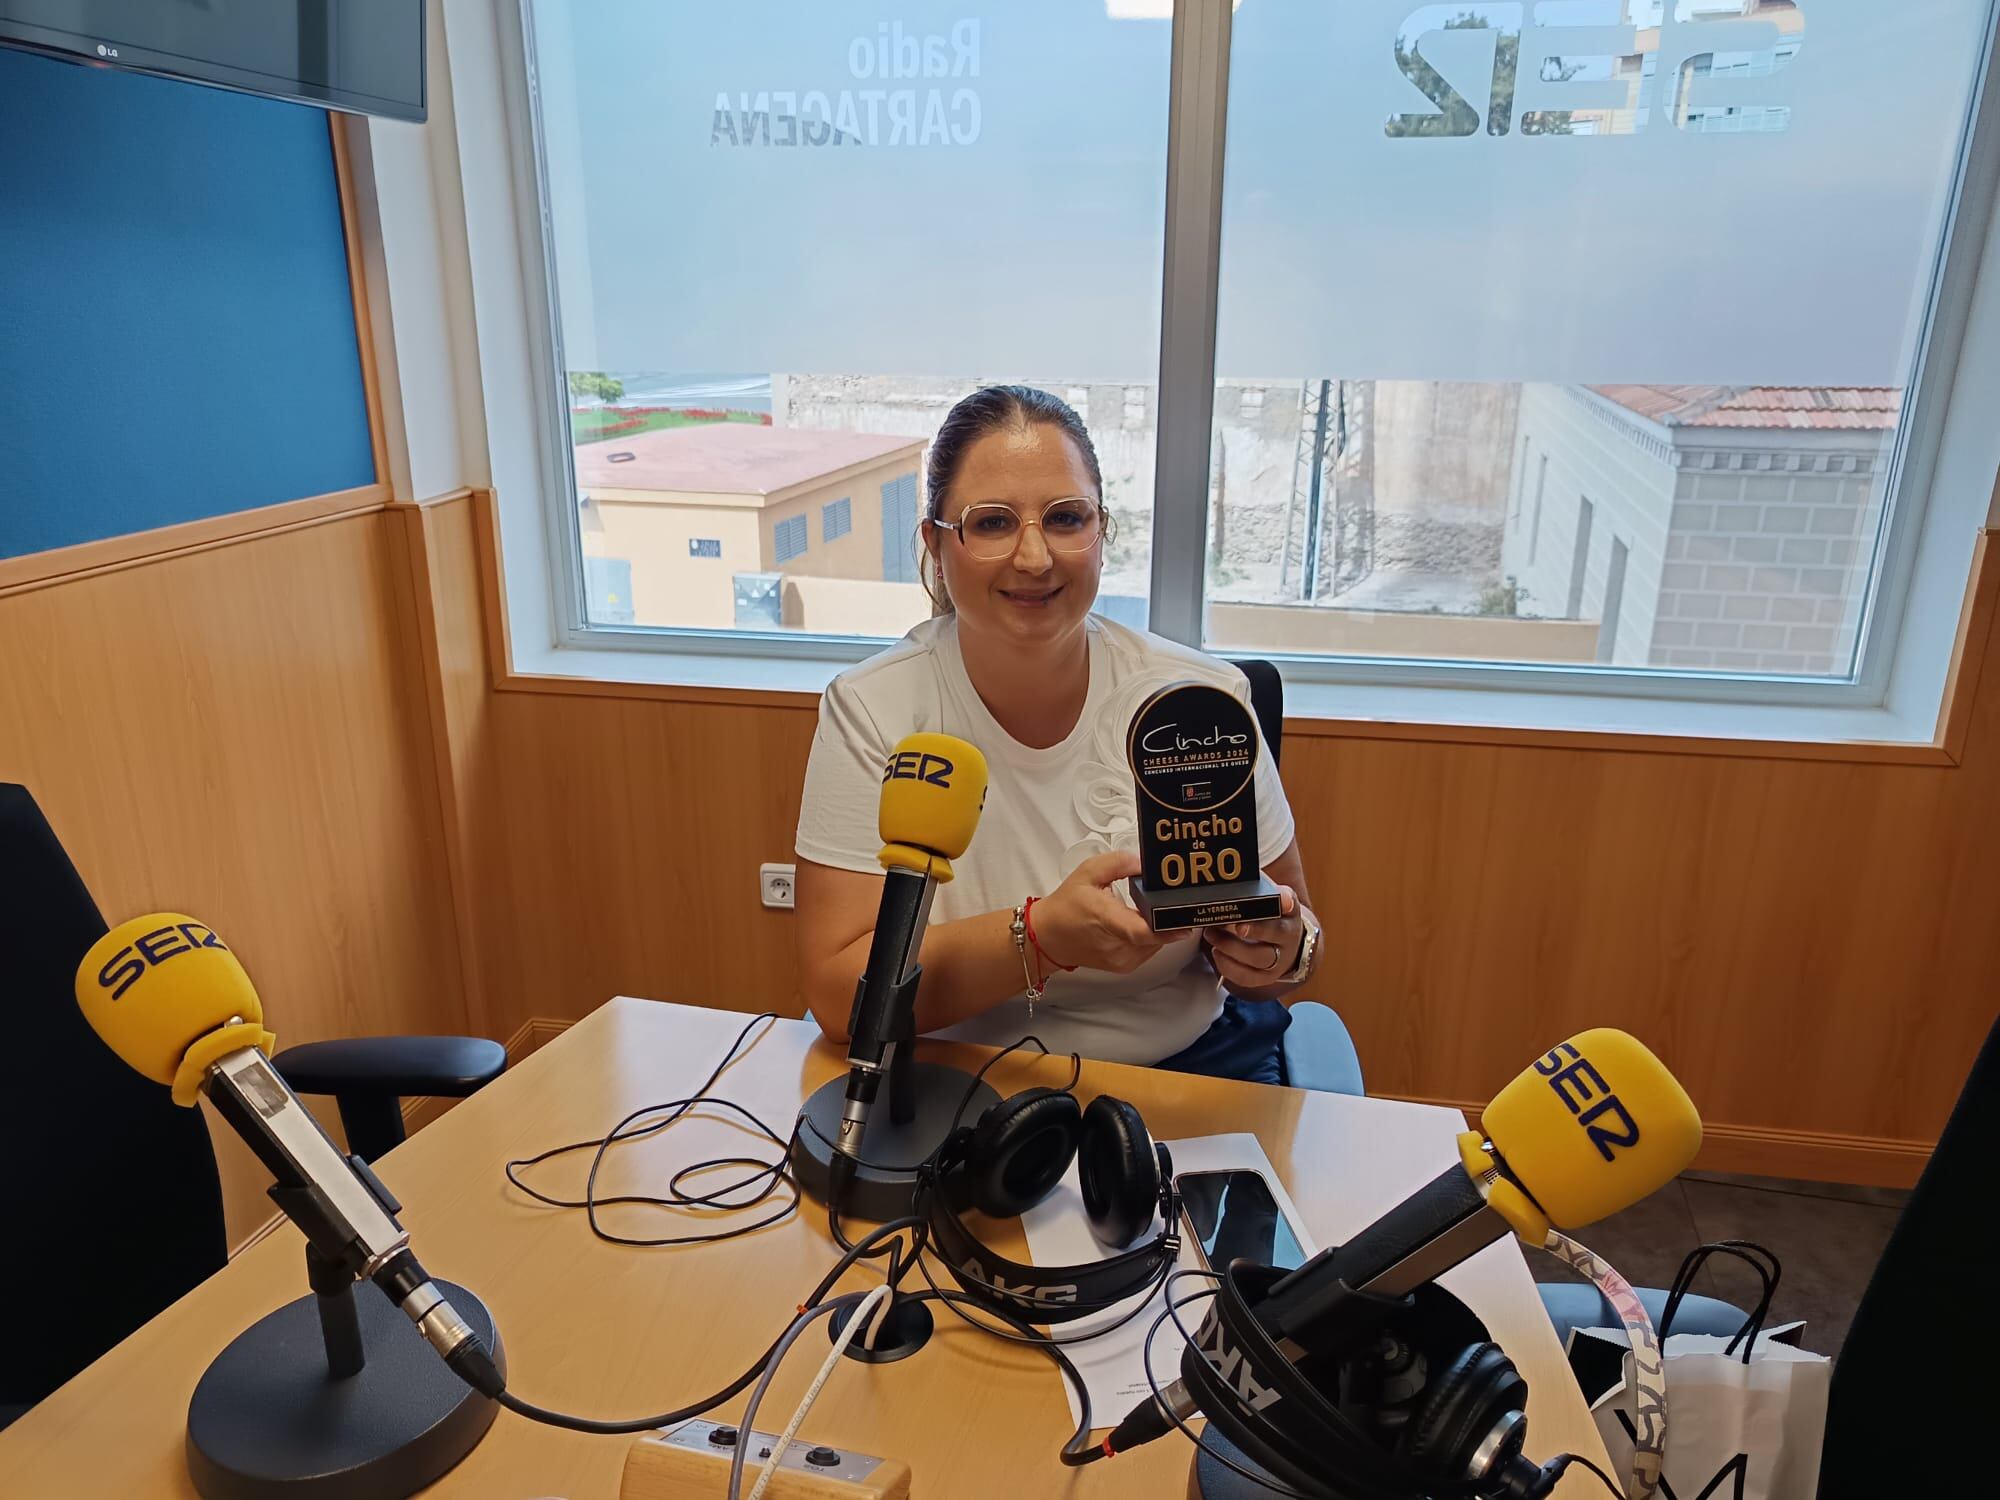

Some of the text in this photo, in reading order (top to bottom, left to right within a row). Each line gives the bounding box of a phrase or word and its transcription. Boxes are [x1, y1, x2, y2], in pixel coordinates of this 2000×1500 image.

[107, 47, 118, 57] LG
[1142, 722, 1248, 753] Cincho
[882, 751, 954, 789] SER
[1142, 755, 1179, 767] CHEESE
[1183, 751, 1222, 762] AWARDS
[1144, 765, 1175, 776] CONCURSO
[1220, 760, 1229, 768] DE
[1155, 813, 1242, 842] Cincho
[1192, 839, 1206, 850] de
[1160, 847, 1242, 887] ORO
[1196, 907, 1207, 916] LA
[98, 923, 228, 1001] SER
[1532, 1042, 1641, 1163] SER
[960, 1256, 1078, 1310] AKG
